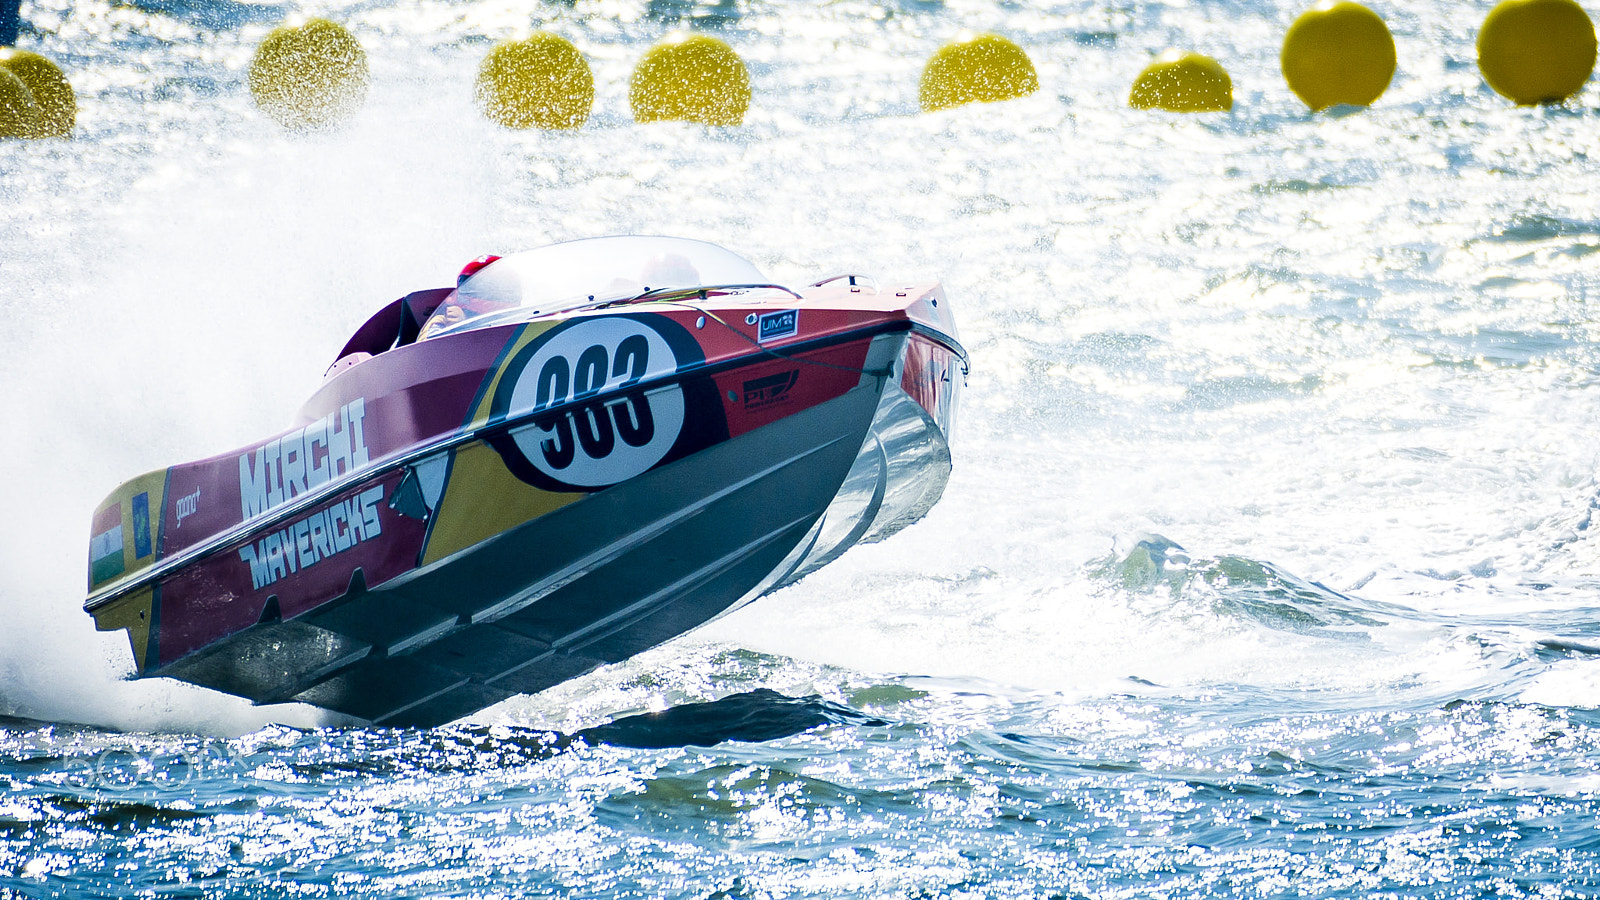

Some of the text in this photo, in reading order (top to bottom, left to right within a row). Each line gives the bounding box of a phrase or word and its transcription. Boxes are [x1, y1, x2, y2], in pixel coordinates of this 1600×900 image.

[763, 318, 782, 331] UIM
[239, 397, 369, 523] MIRCHI
[533, 334, 655, 470] 903
[238, 484, 384, 591] MAVERICKS
